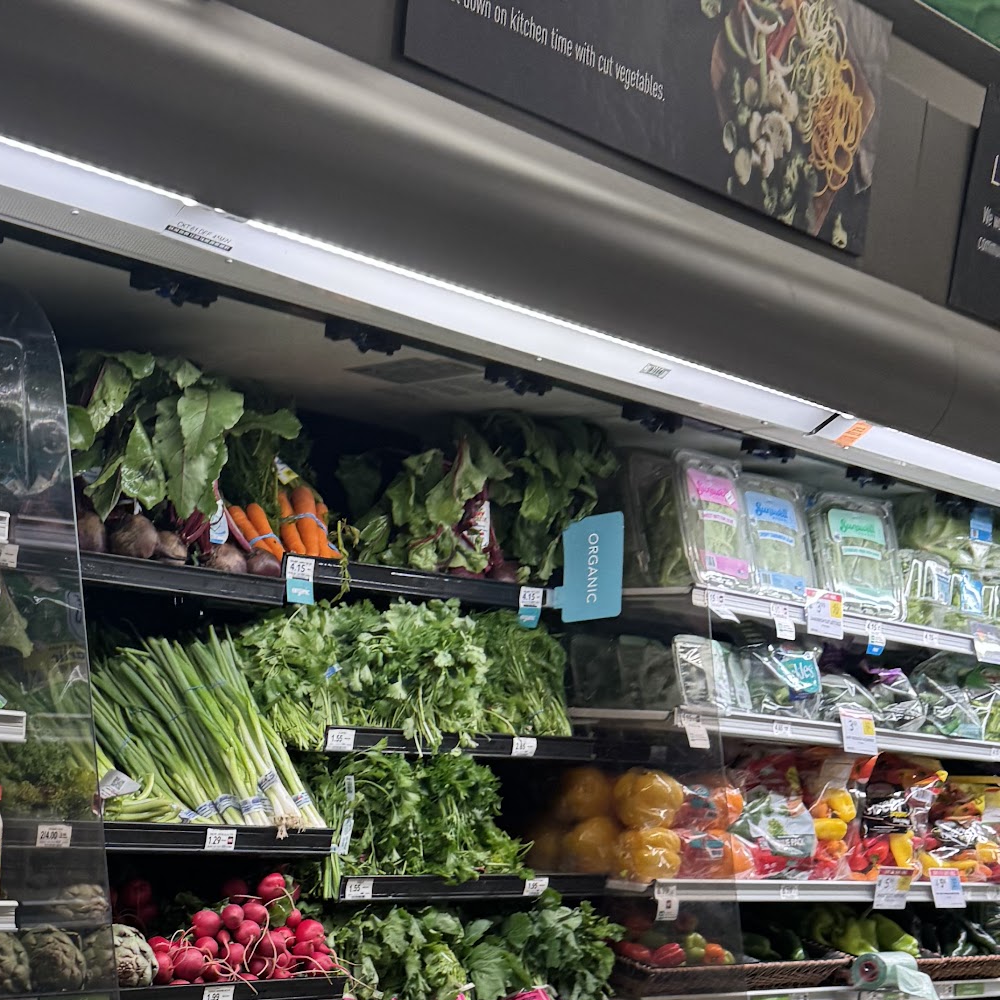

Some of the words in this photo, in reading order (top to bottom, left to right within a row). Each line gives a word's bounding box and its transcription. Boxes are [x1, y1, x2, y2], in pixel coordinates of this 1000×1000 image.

[494, 4, 507, 25] on
[510, 7, 548, 46] kitchen
[550, 27, 573, 57] time
[575, 42, 595, 68] with
[598, 55, 613, 77] cut
[615, 61, 666, 102] vegetables.
[290, 563, 305, 573] 4.15
[586, 533, 599, 604] ORGANIC
[522, 592, 535, 601] 4.15
[208, 836, 221, 845] 1.29
[207, 992, 220, 1000] 1.99
